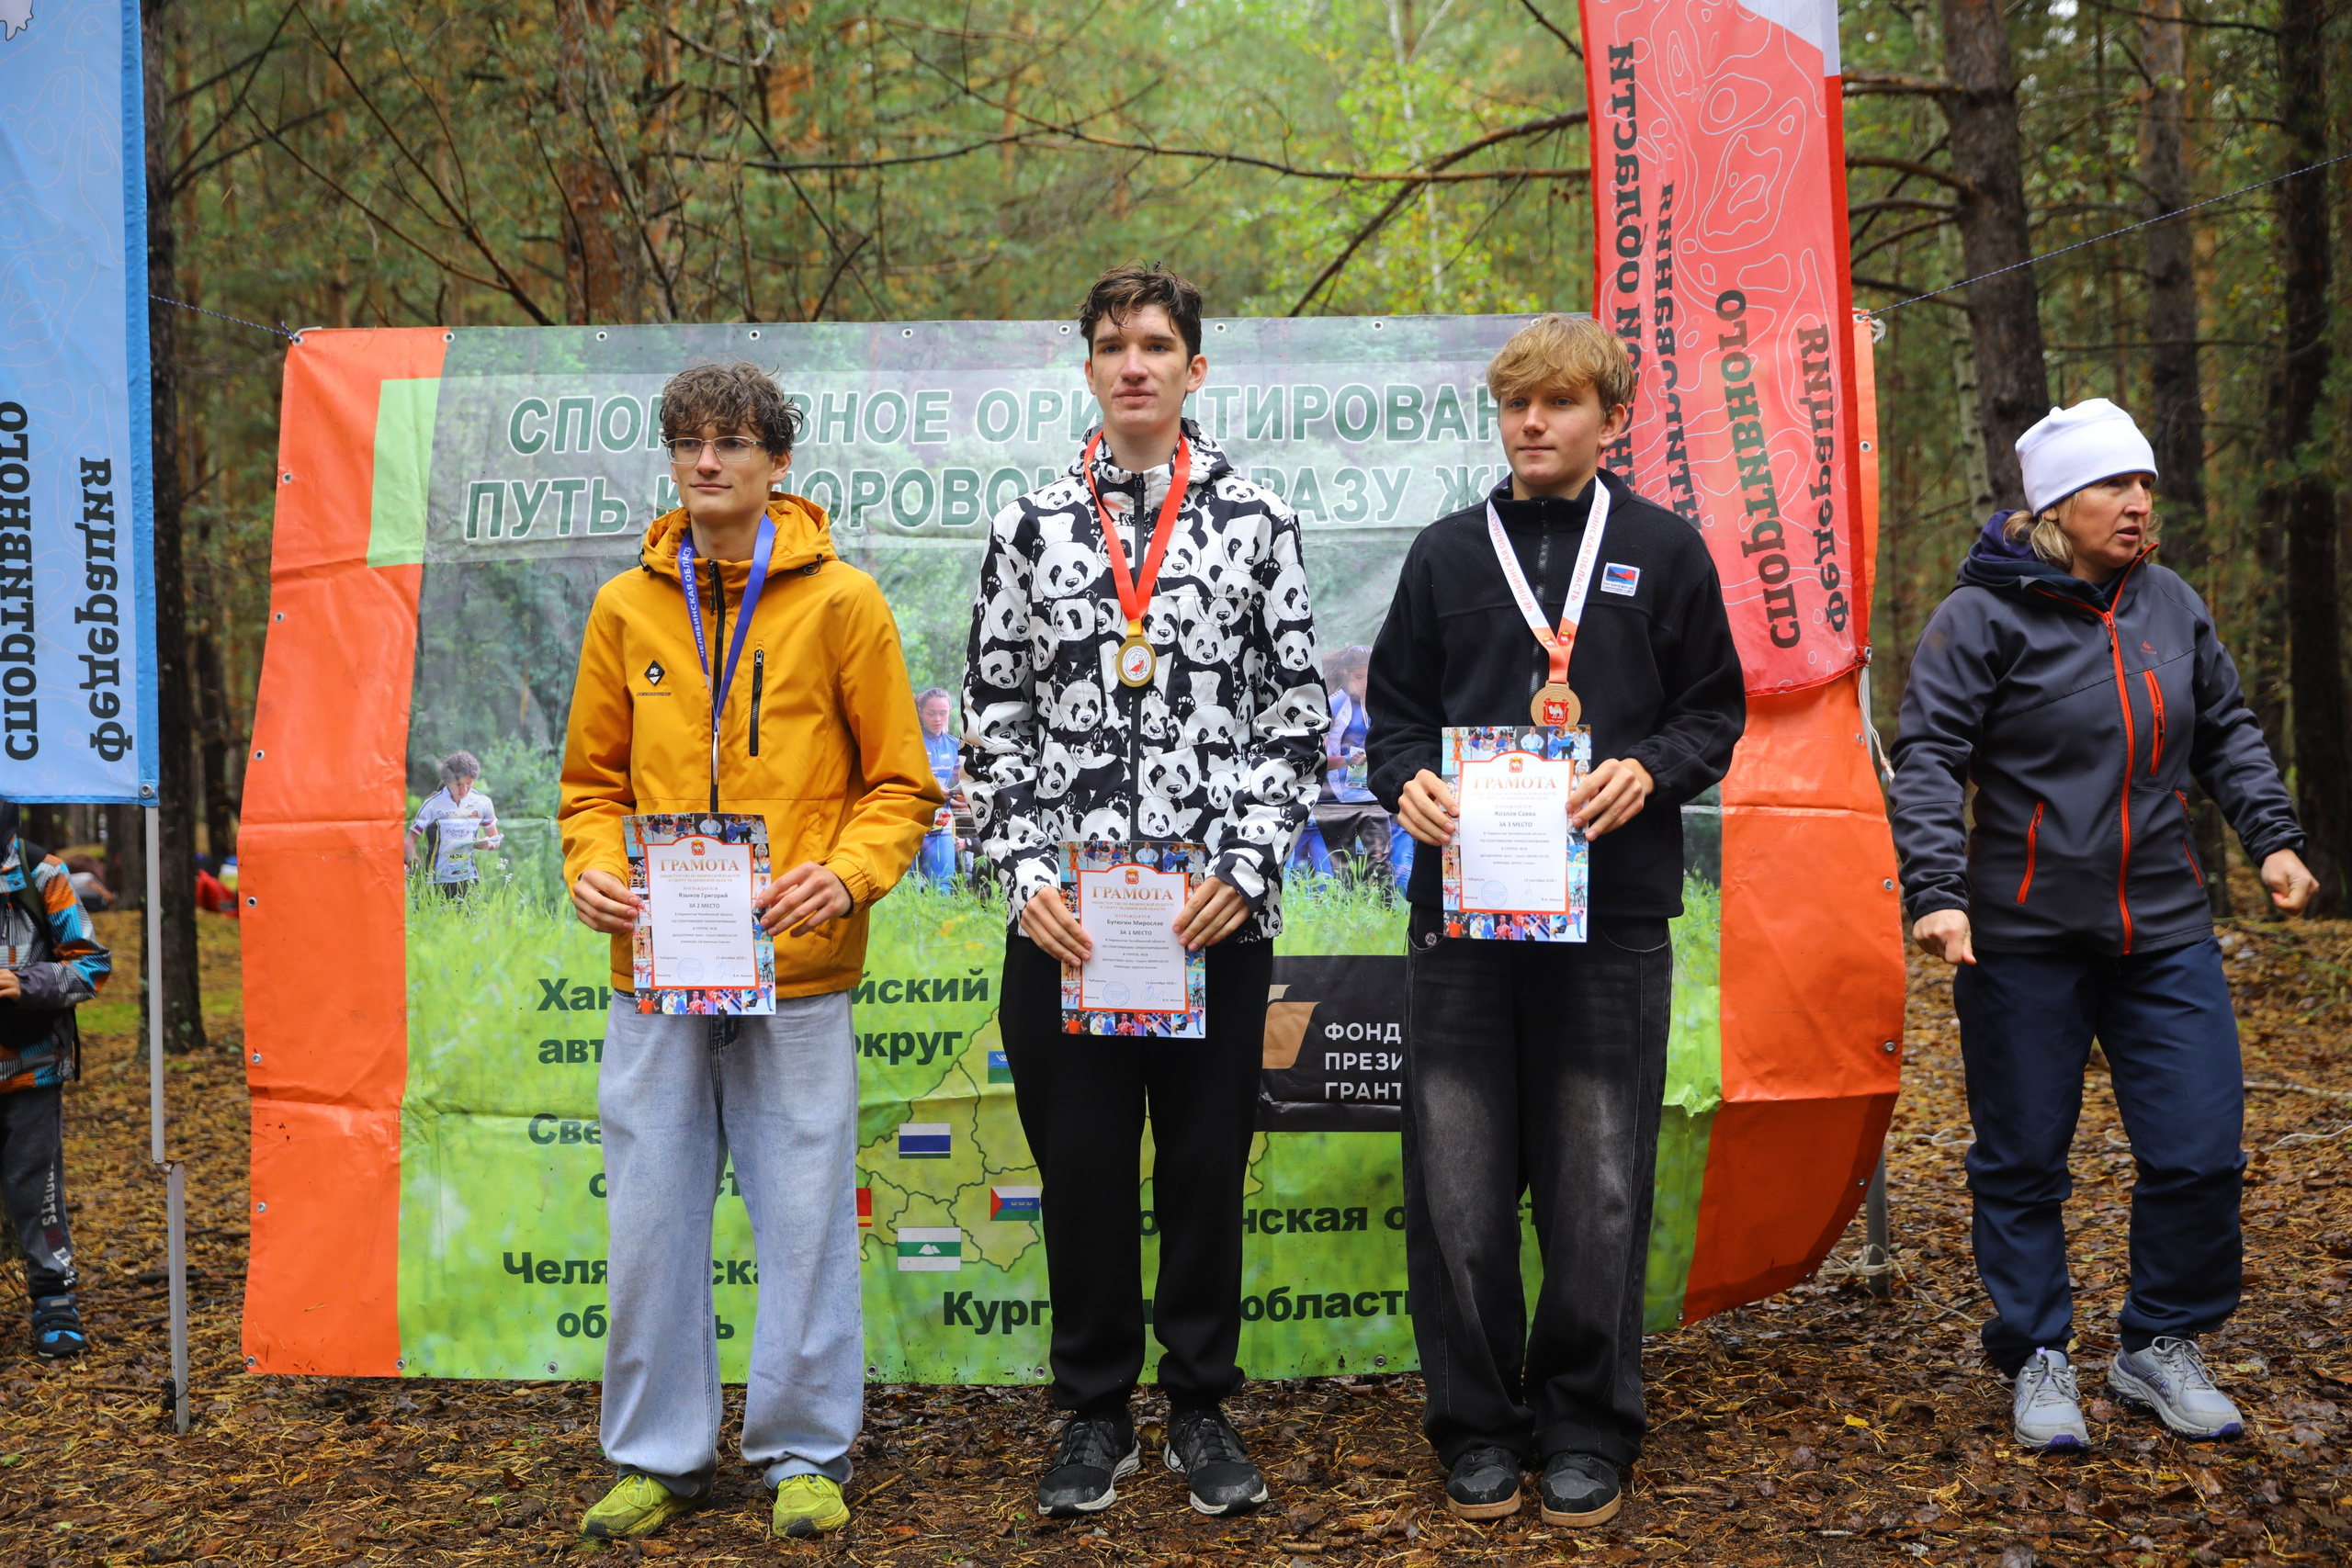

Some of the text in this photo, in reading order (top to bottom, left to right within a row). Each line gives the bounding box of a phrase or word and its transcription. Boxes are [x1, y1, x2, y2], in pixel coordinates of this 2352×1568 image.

[465, 478, 629, 539] ПУТЬ
[1571, 489, 1605, 602] ЧЕЛЯБИНСКАЯ ОБЛАСТЬ
[1490, 511, 1532, 613] ЧЕЛЯБИНСКАЯ ОБЛАСТЬ
[682, 547, 705, 657] ЧЕЛЯБИНСКАЯ ОБЛАСТЬ
[1474, 776, 1556, 789] ГРАМОТА
[660, 858, 741, 872] ГРАМОТА
[1091, 886, 1173, 900] ГРАМОТА
[1324, 1022, 1402, 1044] ФОНД
[1325, 1082, 1402, 1100] ГРАНТ
